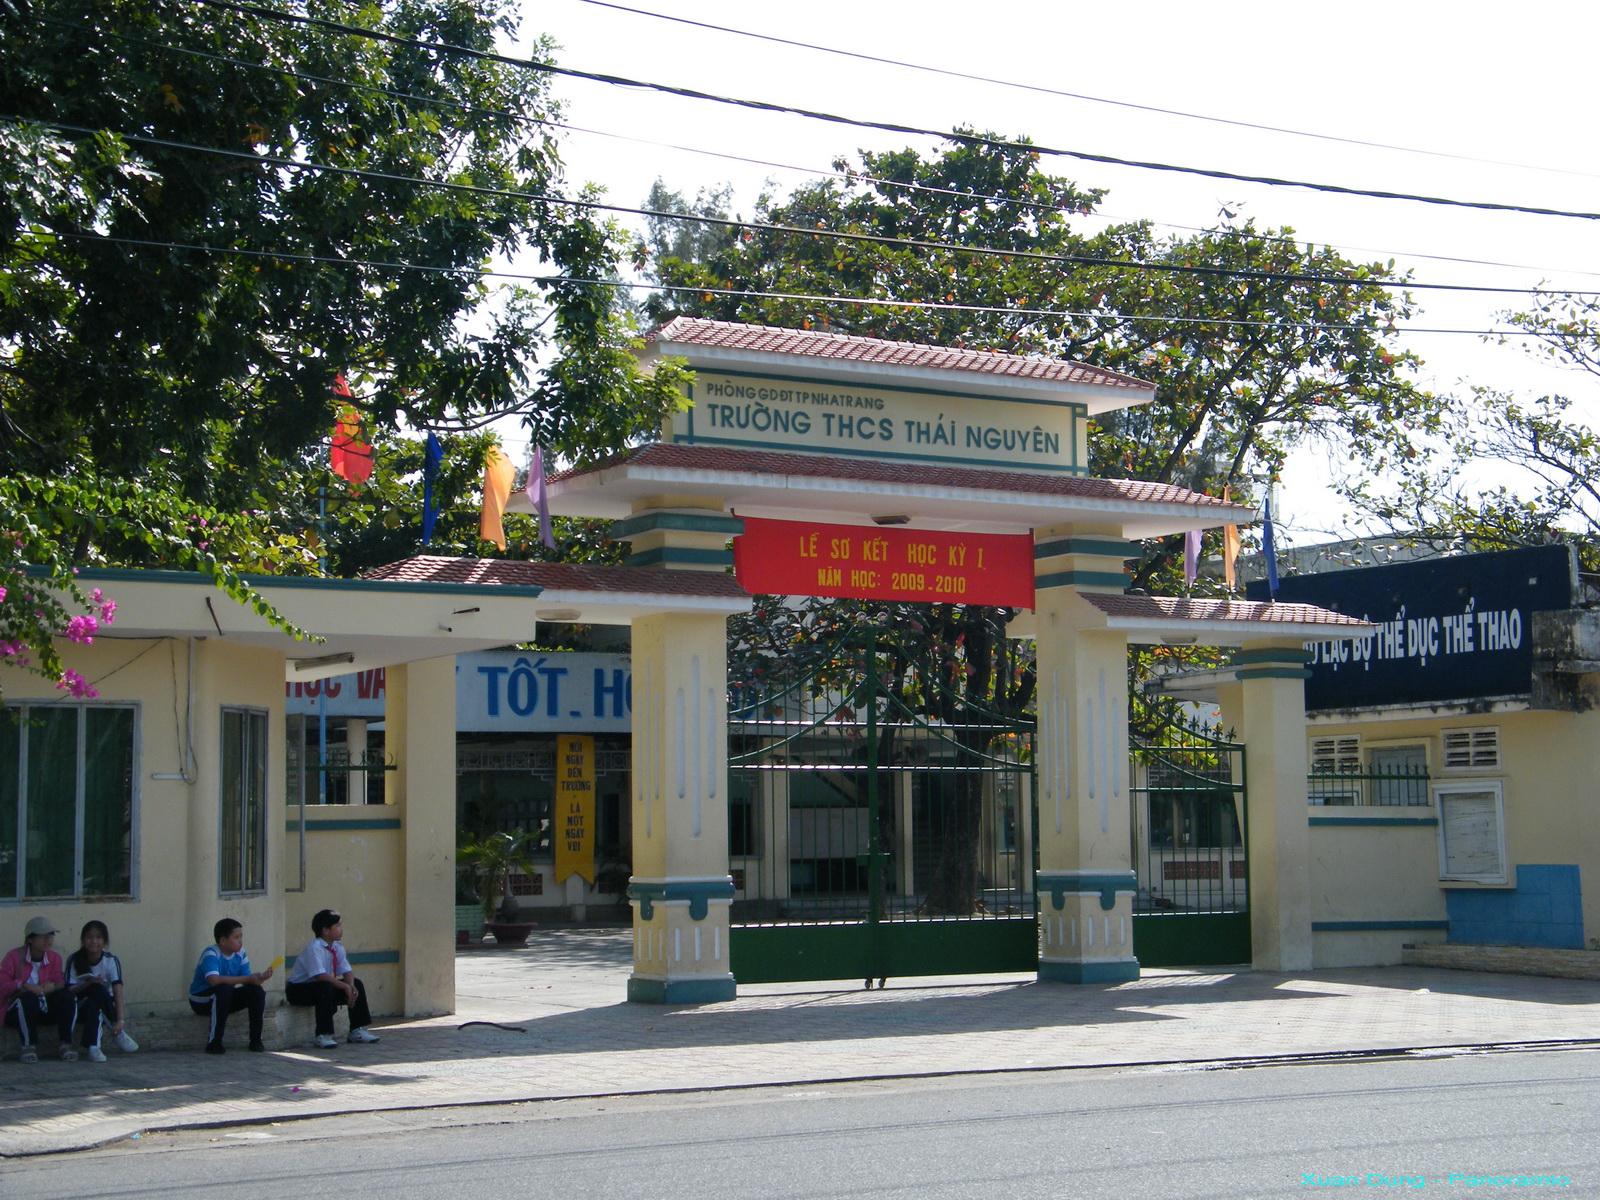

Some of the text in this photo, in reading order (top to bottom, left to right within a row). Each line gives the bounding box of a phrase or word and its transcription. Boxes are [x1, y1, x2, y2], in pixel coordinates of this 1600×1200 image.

[707, 401, 812, 435] TRƯỜNG
[822, 413, 894, 441] THCS
[966, 425, 1060, 454] NGUYÊN
[863, 536, 889, 561] KẾT
[907, 543, 937, 568] HỌC
[948, 542, 967, 566] KỲ
[1375, 604, 1406, 660] THỂ
[1408, 616, 1439, 668] DỤC
[1443, 596, 1475, 655] THỂ
[1478, 608, 1522, 651] THAO
[477, 657, 568, 717] TỐT
